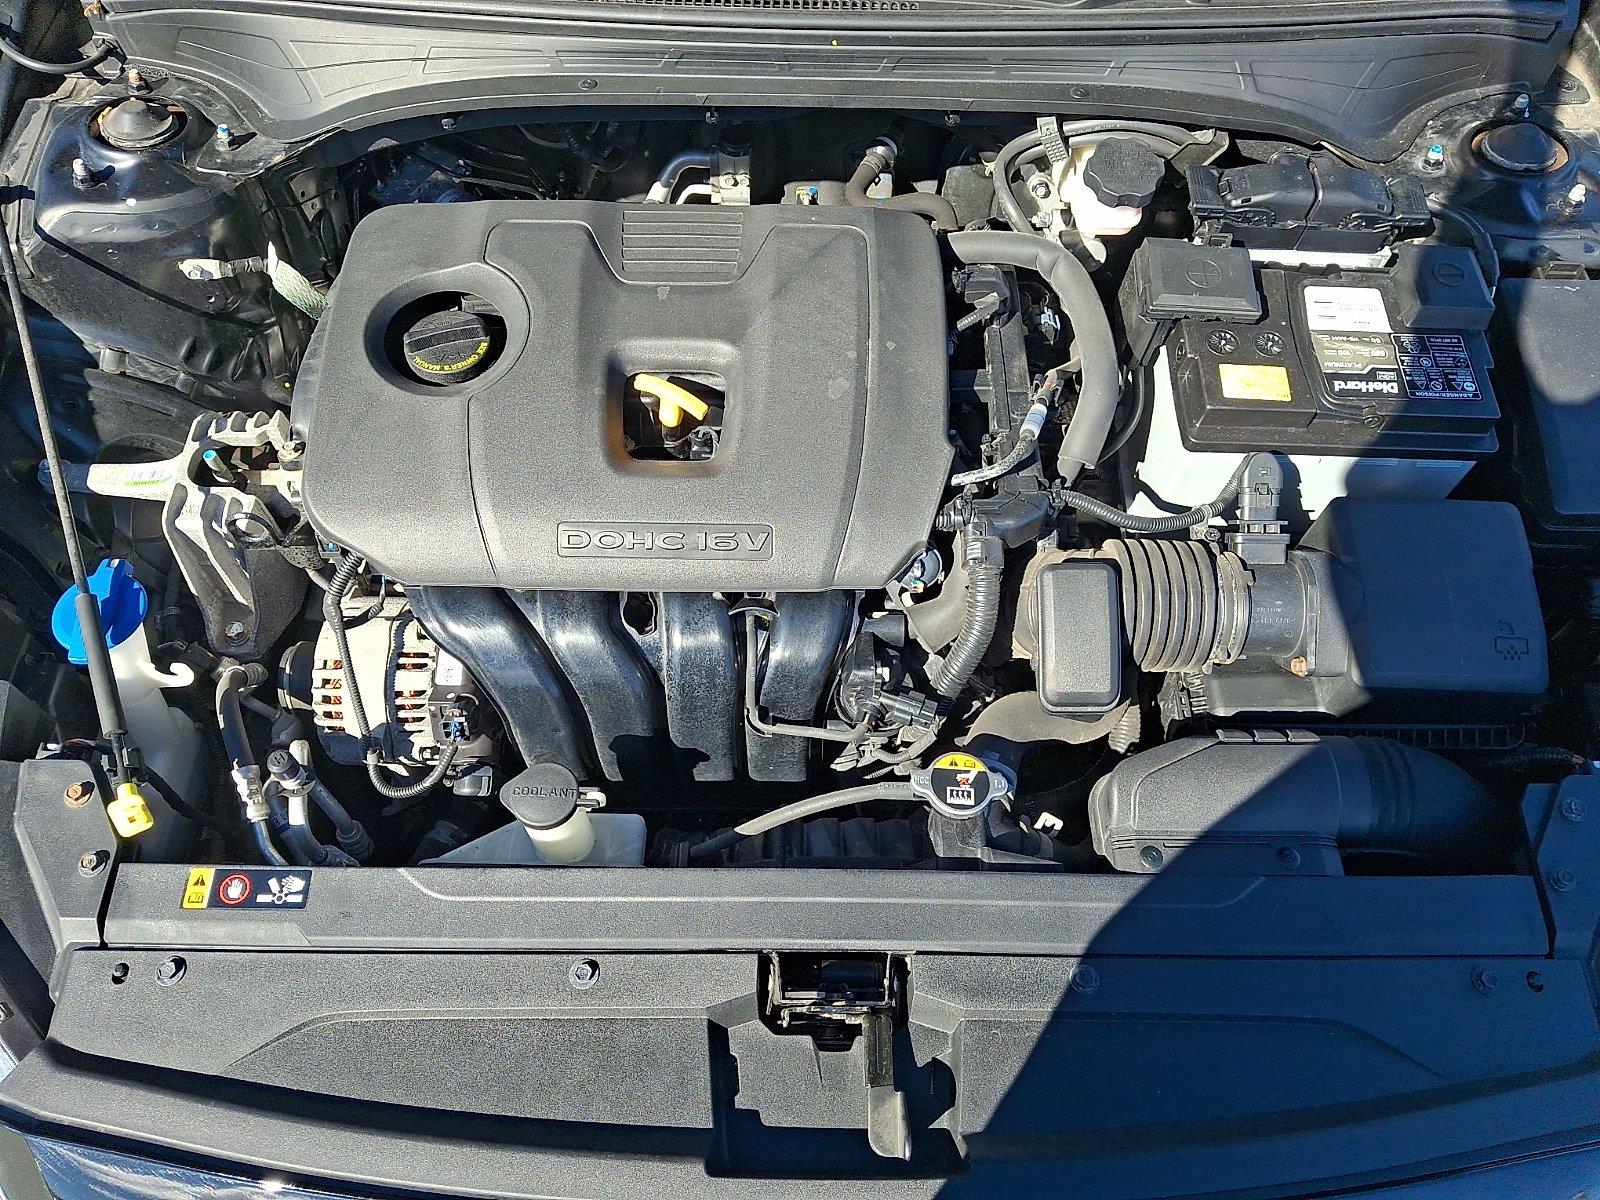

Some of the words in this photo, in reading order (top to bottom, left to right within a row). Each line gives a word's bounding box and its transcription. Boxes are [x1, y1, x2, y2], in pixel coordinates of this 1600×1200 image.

[476, 342, 488, 354] SEE
[412, 355, 441, 371] MANUAL
[443, 354, 479, 371] OWNER'S
[1334, 381, 1399, 393] DieHard
[560, 529, 686, 551] DOHC
[697, 531, 770, 551] 16V
[513, 786, 577, 799] COOLANT
